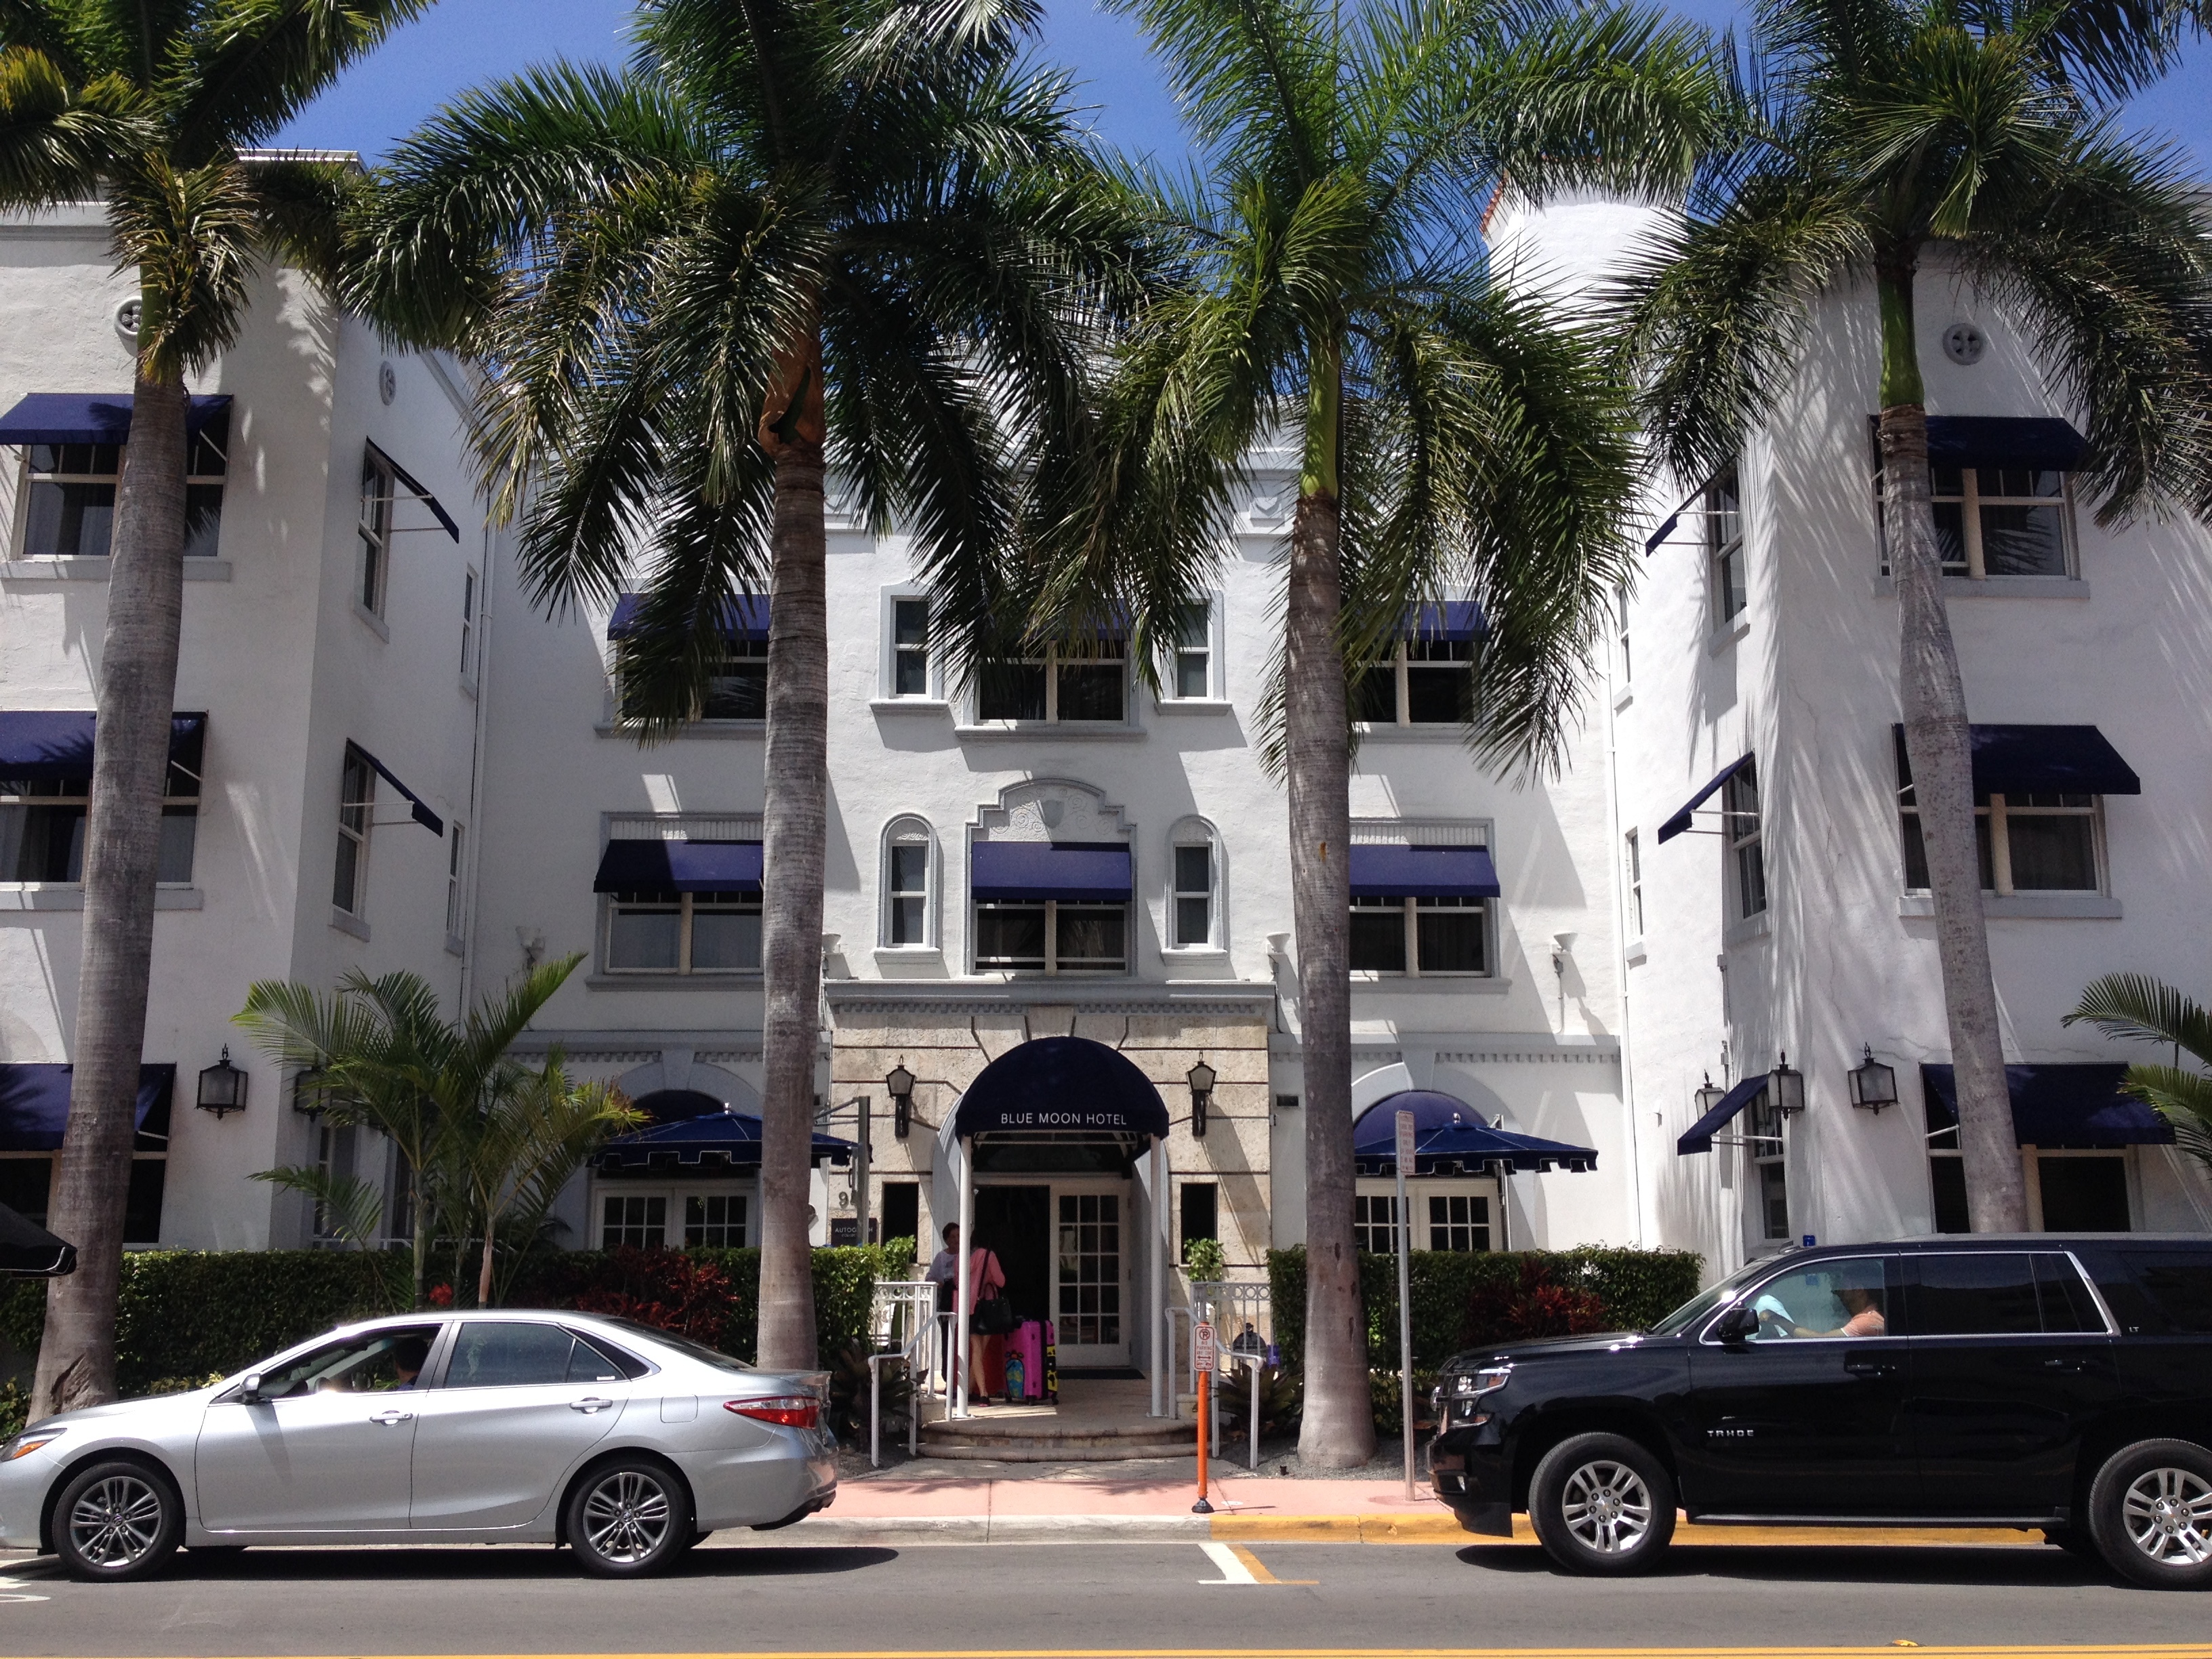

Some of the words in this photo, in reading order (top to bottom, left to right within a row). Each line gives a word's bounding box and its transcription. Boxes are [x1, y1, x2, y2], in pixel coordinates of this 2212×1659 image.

[1001, 1113, 1033, 1124] BLUE
[1039, 1112, 1080, 1124] MOON
[1086, 1113, 1127, 1125] HOTEL
